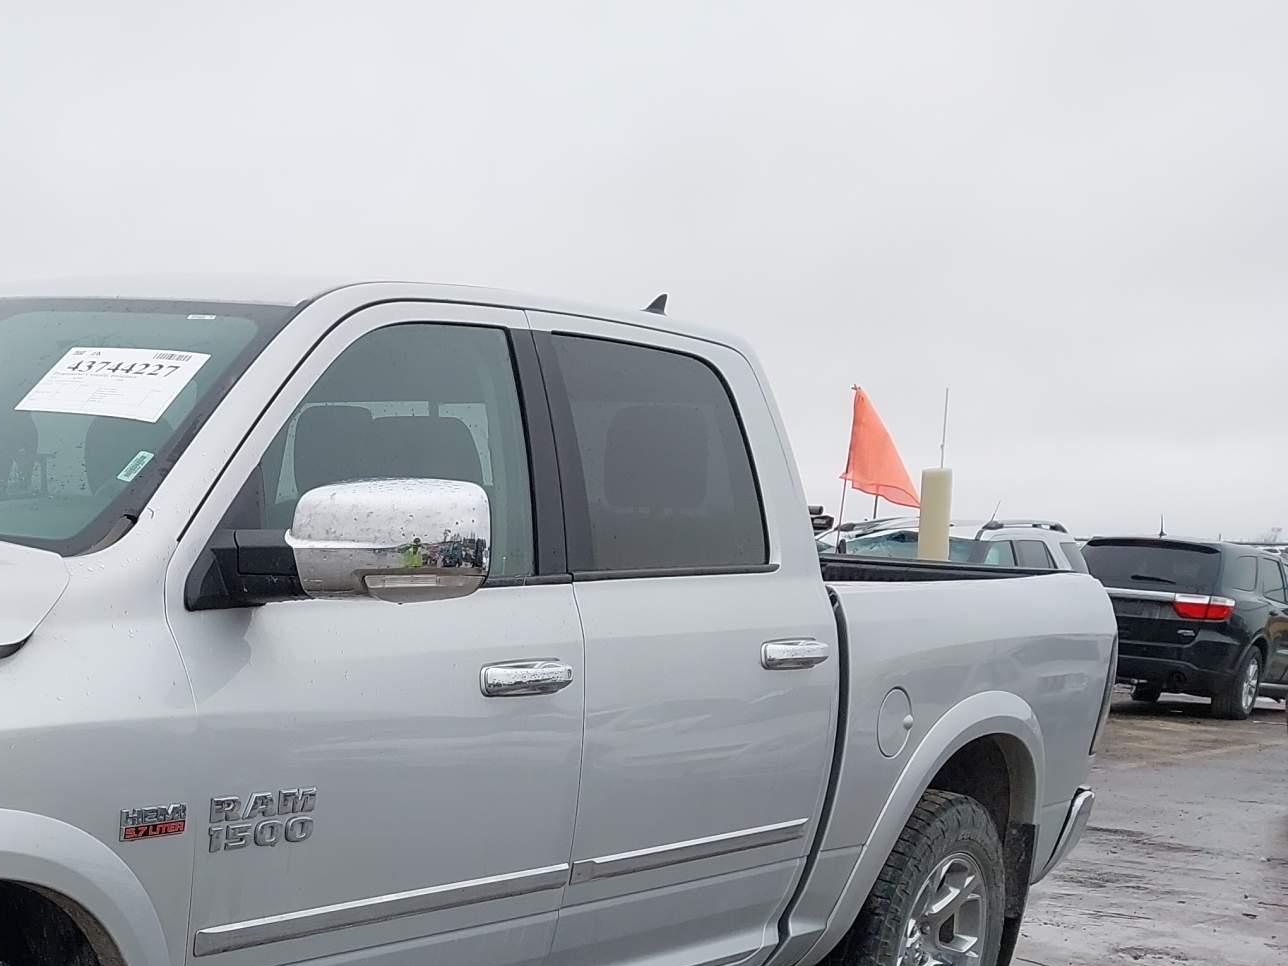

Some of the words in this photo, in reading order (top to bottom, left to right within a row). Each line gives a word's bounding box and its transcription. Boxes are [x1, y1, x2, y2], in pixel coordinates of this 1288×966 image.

[67, 360, 181, 378] 43744227
[119, 803, 187, 826] HEMI
[209, 786, 318, 824] RAM
[147, 820, 186, 838] LITER
[208, 816, 314, 853] 1500
